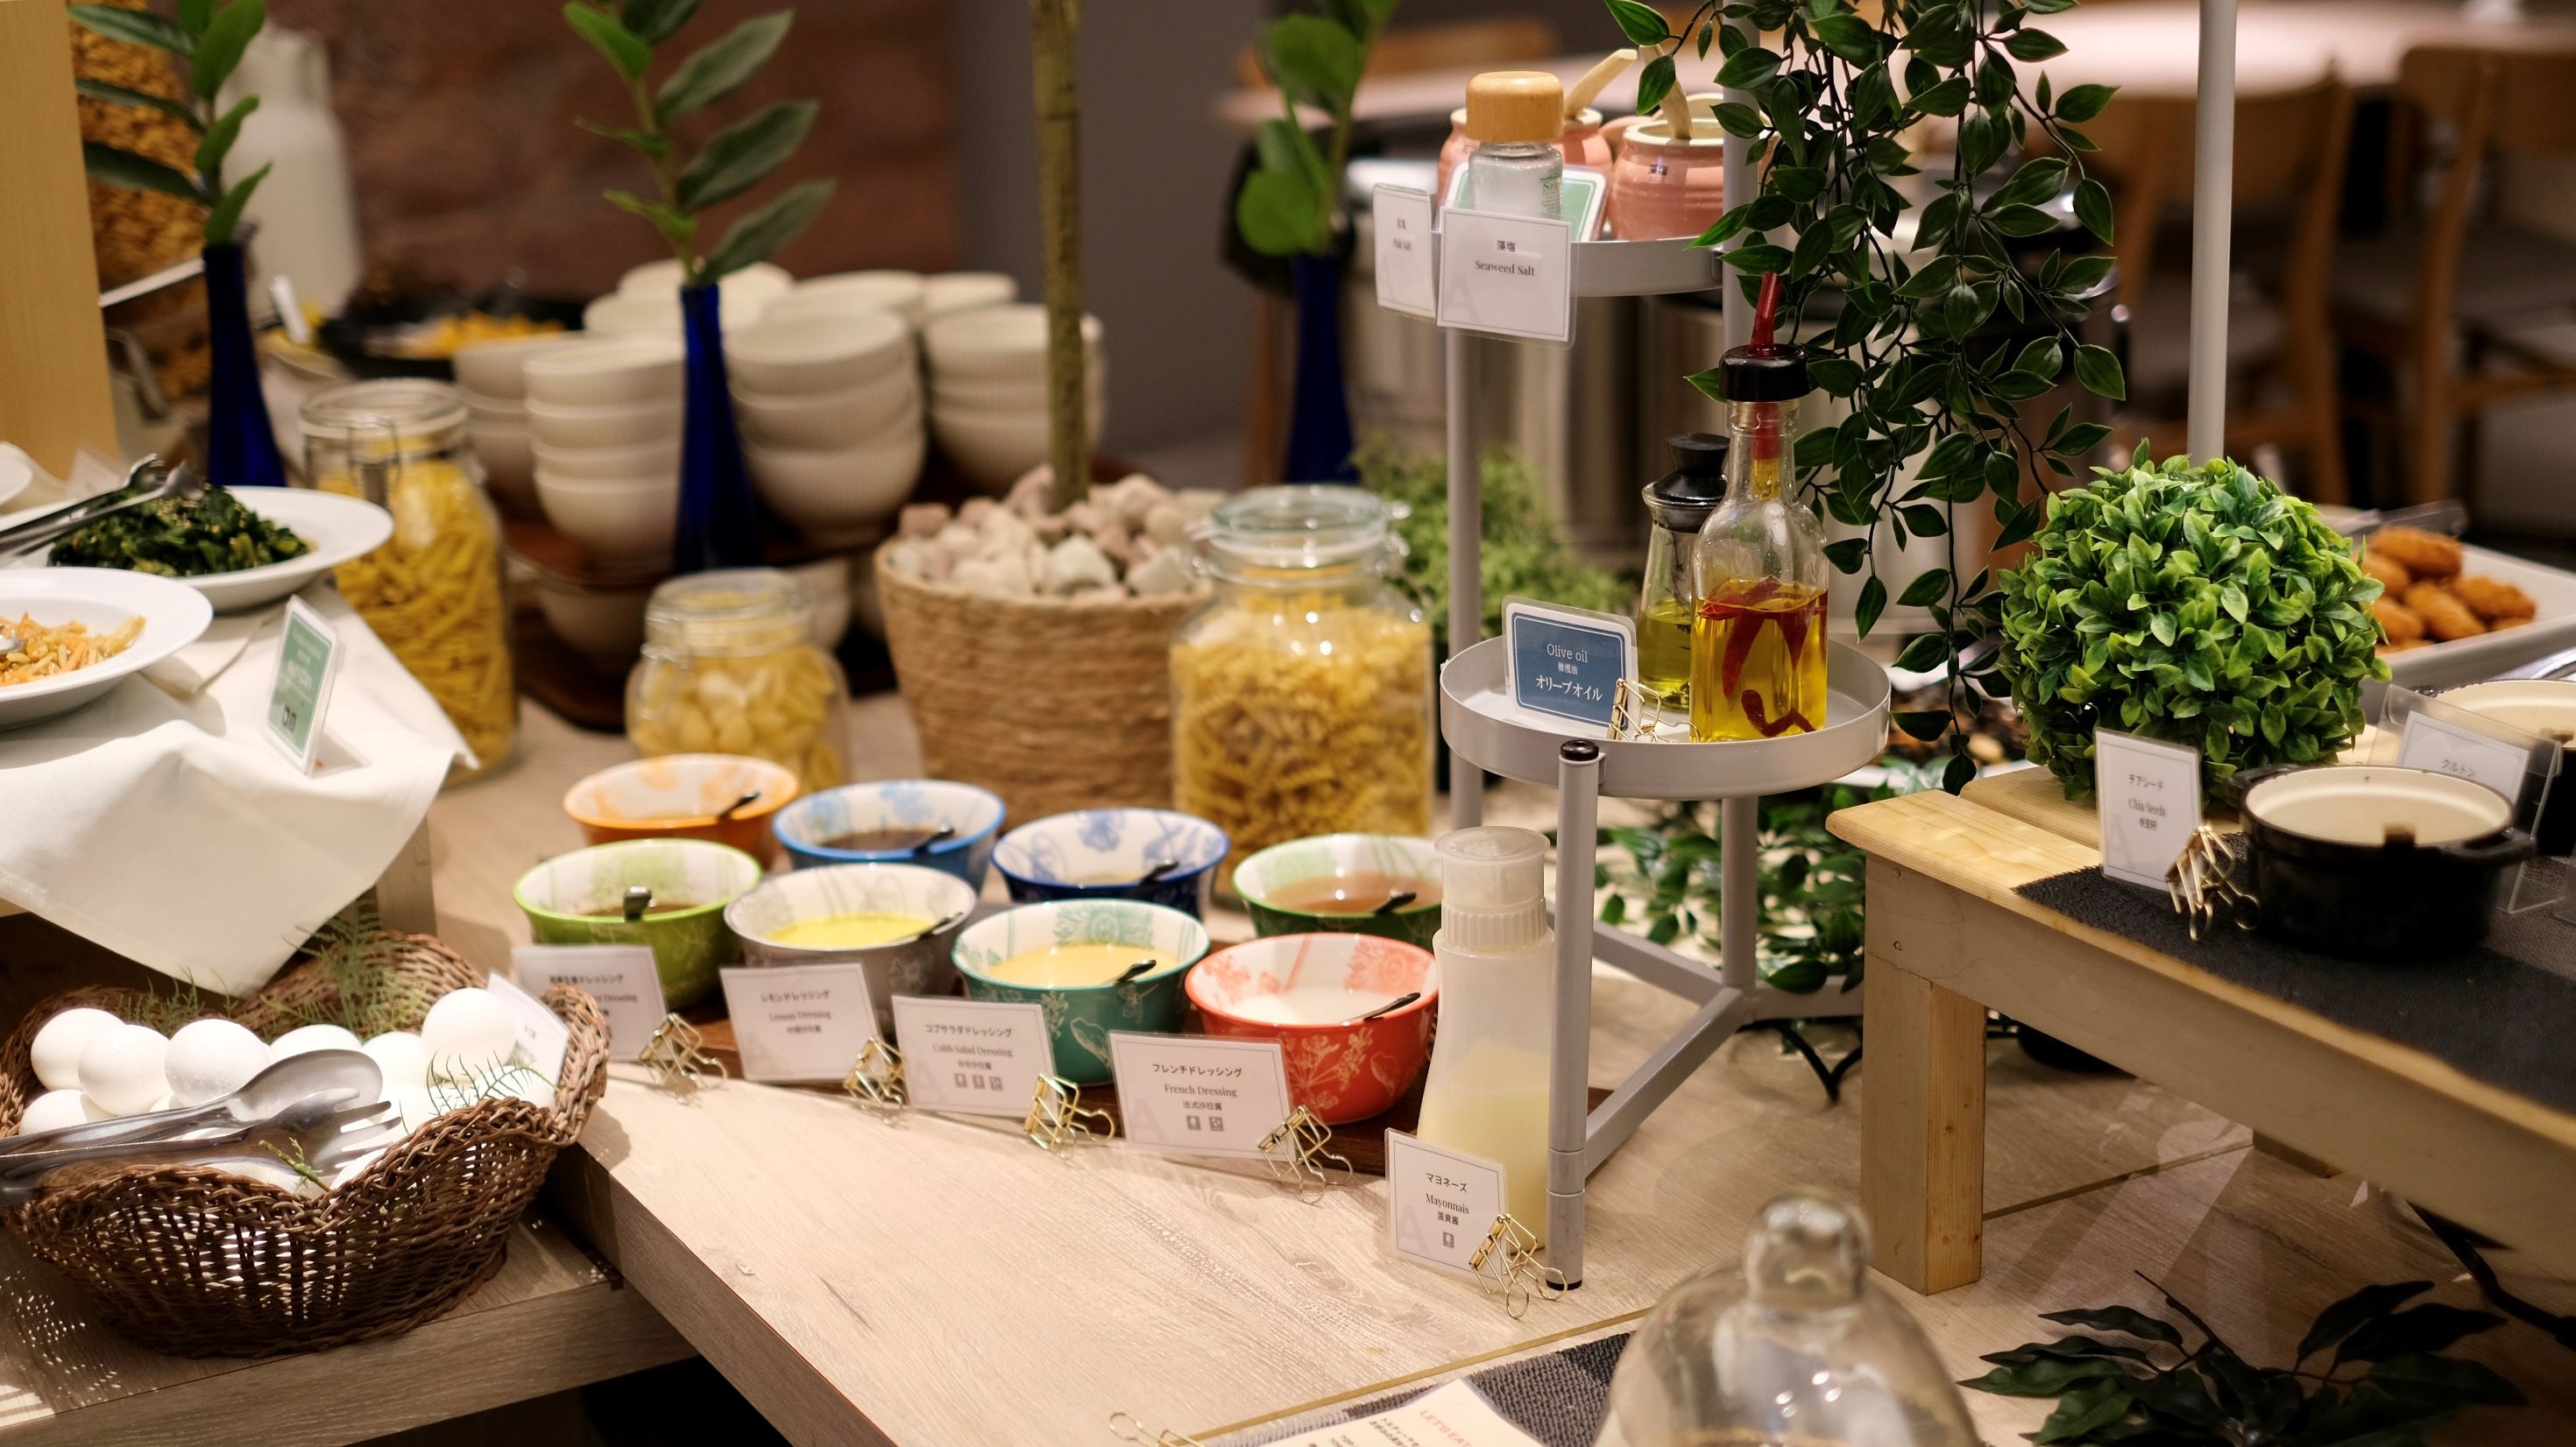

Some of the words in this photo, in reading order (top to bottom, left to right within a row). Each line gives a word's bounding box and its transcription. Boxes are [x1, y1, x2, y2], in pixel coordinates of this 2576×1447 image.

[1475, 260, 1515, 274] Seaweed
[1517, 265, 1535, 277] Salt
[1546, 643, 1573, 660] Olive
[1575, 650, 1589, 663] oil
[1535, 674, 1603, 702] オリーブオイル
[2128, 774, 2163, 791] チアシード
[2128, 798, 2144, 812] Chia
[2145, 802, 2166, 816] Seeds
[761, 989, 829, 1003] レモンドレッシング
[797, 1010, 832, 1020] Dressing
[925, 1023, 1012, 1037] コブサラダドレッシング
[932, 1043, 953, 1053] Cobb
[954, 1045, 976, 1055] Salad
[977, 1047, 1013, 1057] Dressing
[1152, 1063, 1242, 1077] フレンチドレッシング
[1164, 1083, 1195, 1094] French
[1197, 1085, 1237, 1098] Dressing
[1426, 1173, 1468, 1192] マヨネーズ
[1426, 1193, 1469, 1214] Mayonnais
